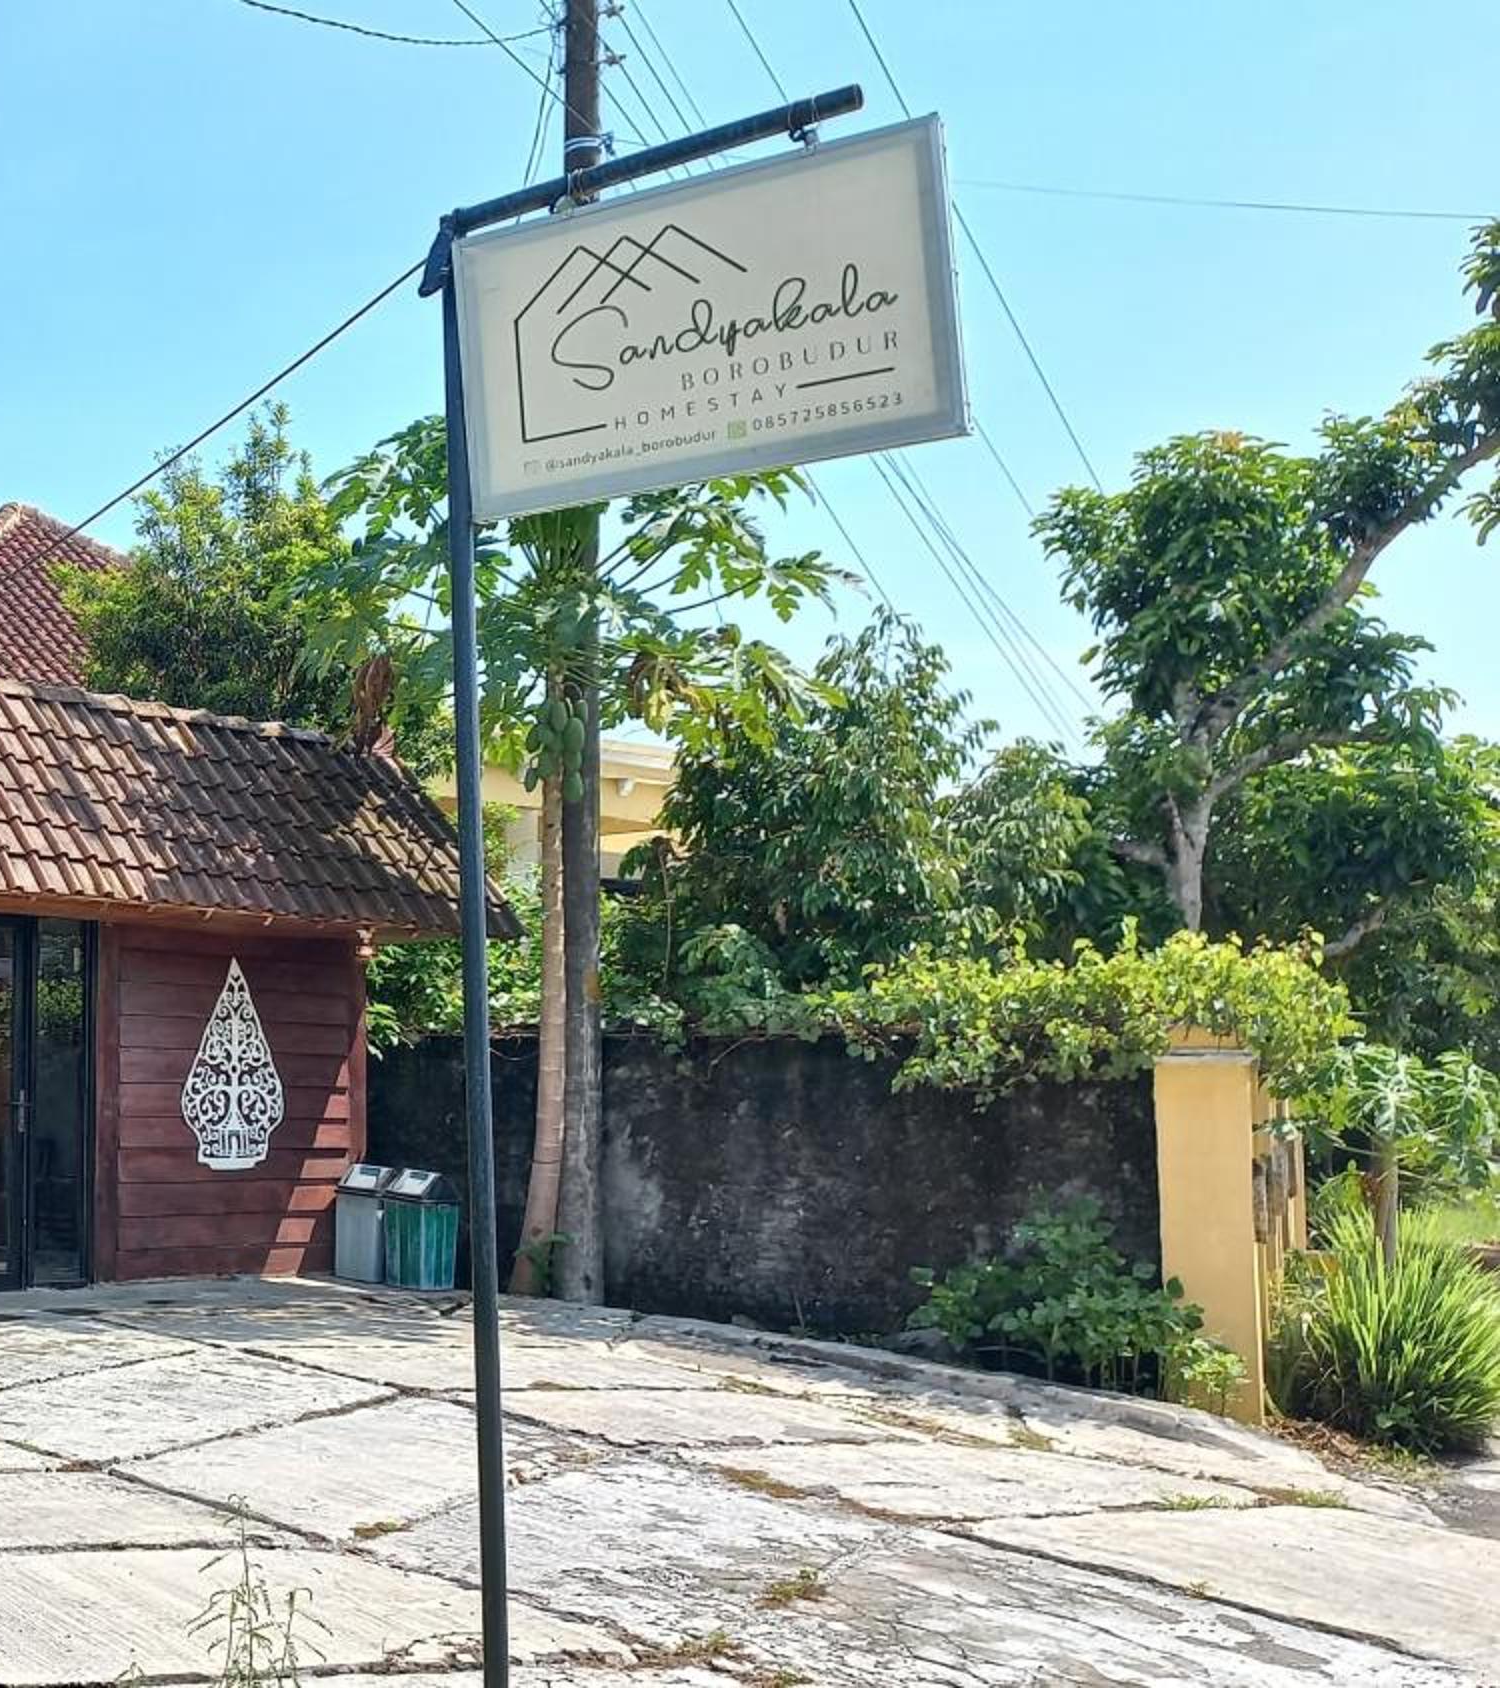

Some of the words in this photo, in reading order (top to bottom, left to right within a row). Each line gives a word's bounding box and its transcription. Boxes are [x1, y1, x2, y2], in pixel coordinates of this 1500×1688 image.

[551, 263, 899, 391] Sandyakala
[681, 330, 899, 391] BOROBUDUR
[545, 430, 716, 471] @sandyakala_borobudur
[752, 391, 904, 431] 085725856523
[615, 384, 786, 431] HOMESTAY
